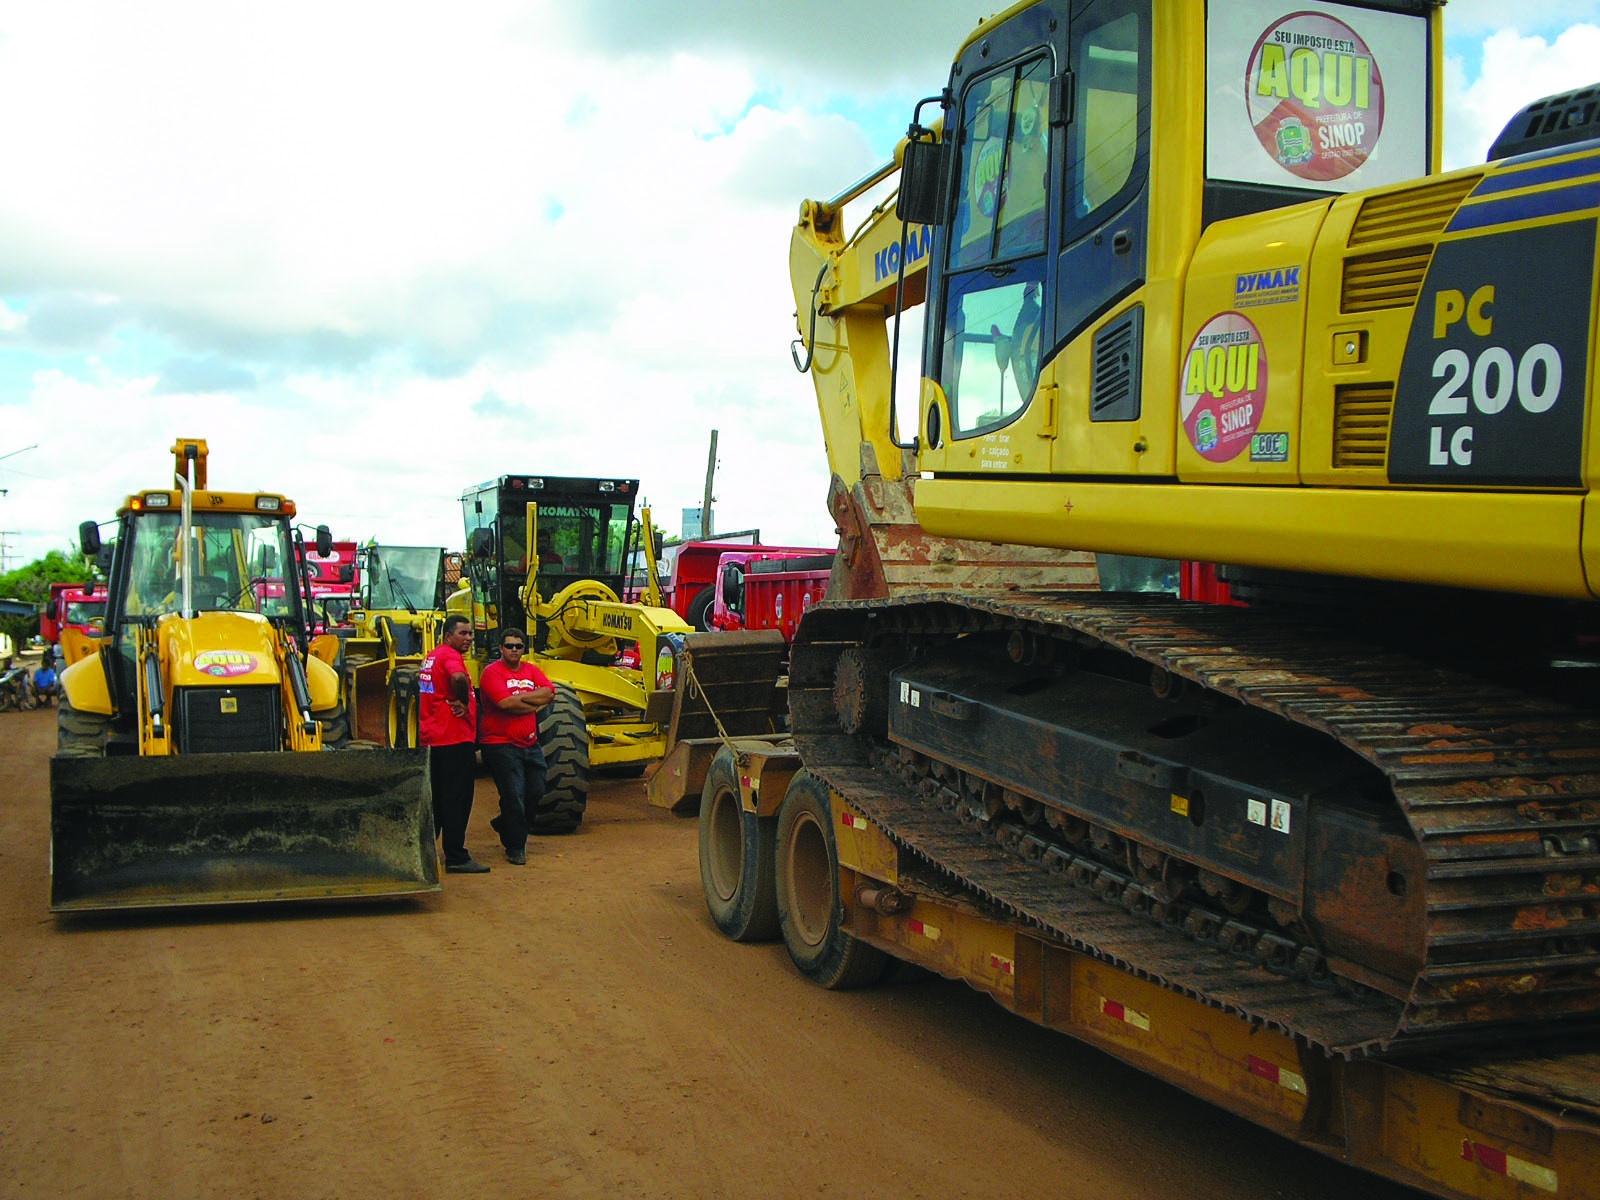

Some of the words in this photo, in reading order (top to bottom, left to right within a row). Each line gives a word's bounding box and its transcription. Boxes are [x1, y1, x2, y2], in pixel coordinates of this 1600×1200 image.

[1275, 30, 1291, 43] SEU
[1293, 33, 1332, 49] IMPOSTO
[1257, 43, 1369, 109] AQUI
[1319, 122, 1365, 149] SINOP
[1236, 267, 1299, 294] DYMAK
[1433, 285, 1495, 339] PC
[1186, 343, 1259, 398] AQUI
[1428, 343, 1563, 415] 200
[1221, 403, 1254, 434] SINOP
[1429, 425, 1473, 466] LC
[603, 612, 632, 631] KOMATSU
